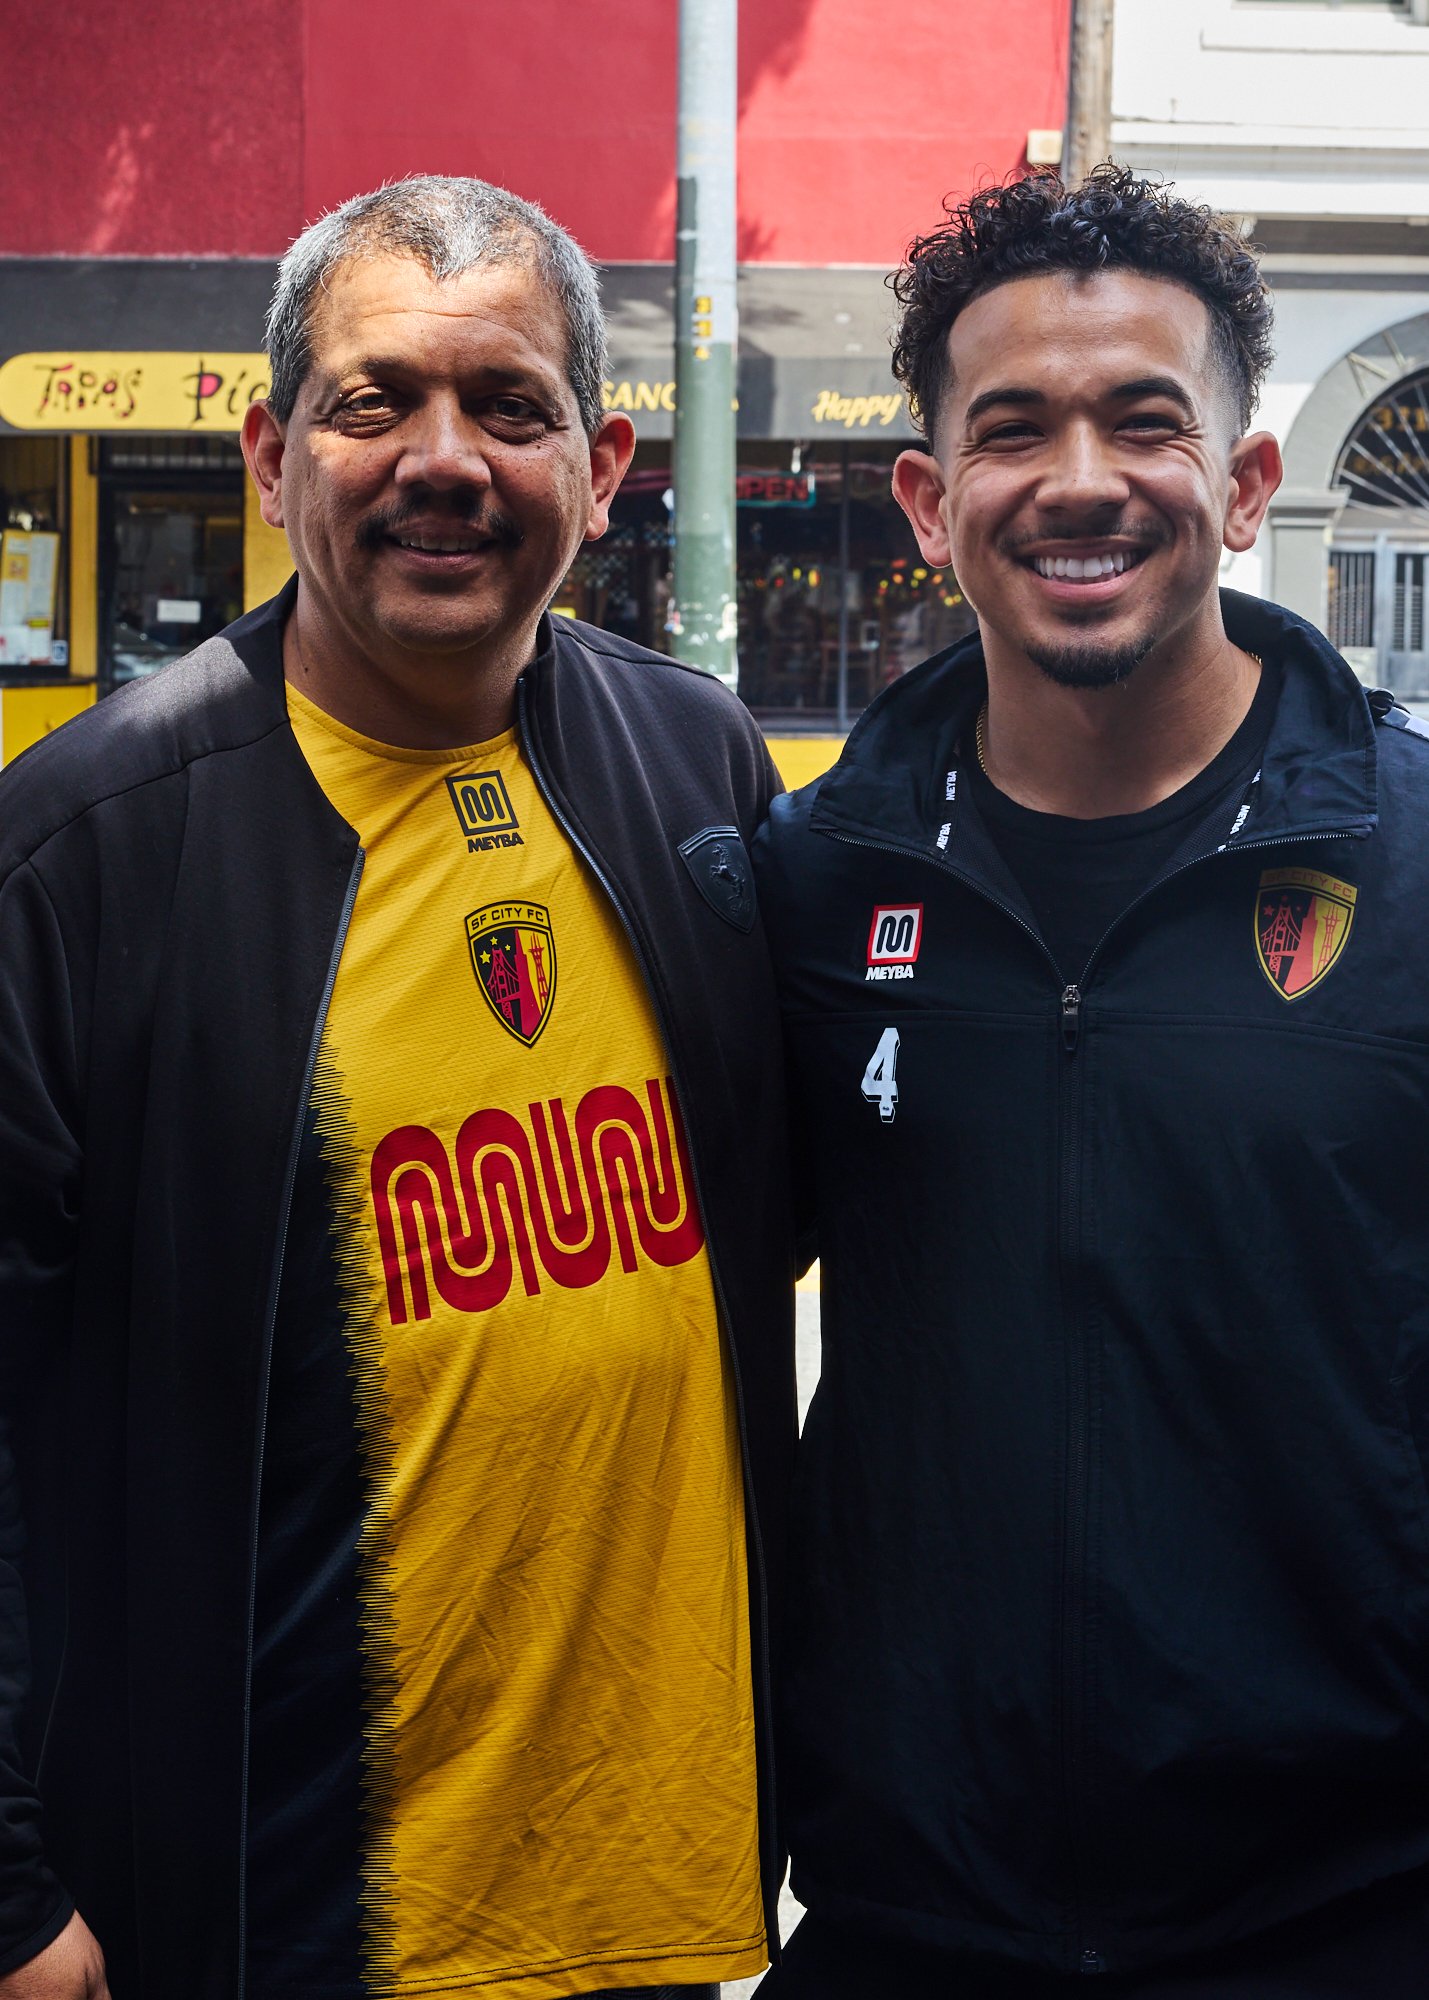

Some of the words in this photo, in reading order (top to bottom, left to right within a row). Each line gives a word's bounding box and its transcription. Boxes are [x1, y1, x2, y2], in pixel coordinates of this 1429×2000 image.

[811, 390, 902, 428] Happy
[945, 770, 958, 801] MEYBA
[467, 831, 525, 853] MEYBA
[1291, 871, 1328, 887] CITY
[1333, 882, 1353, 898] FC
[471, 913, 487, 931] SF
[491, 907, 523, 921] CITY
[527, 908, 544, 923] FC
[865, 964, 914, 981] MEYBA
[861, 1027, 900, 1123] 4
